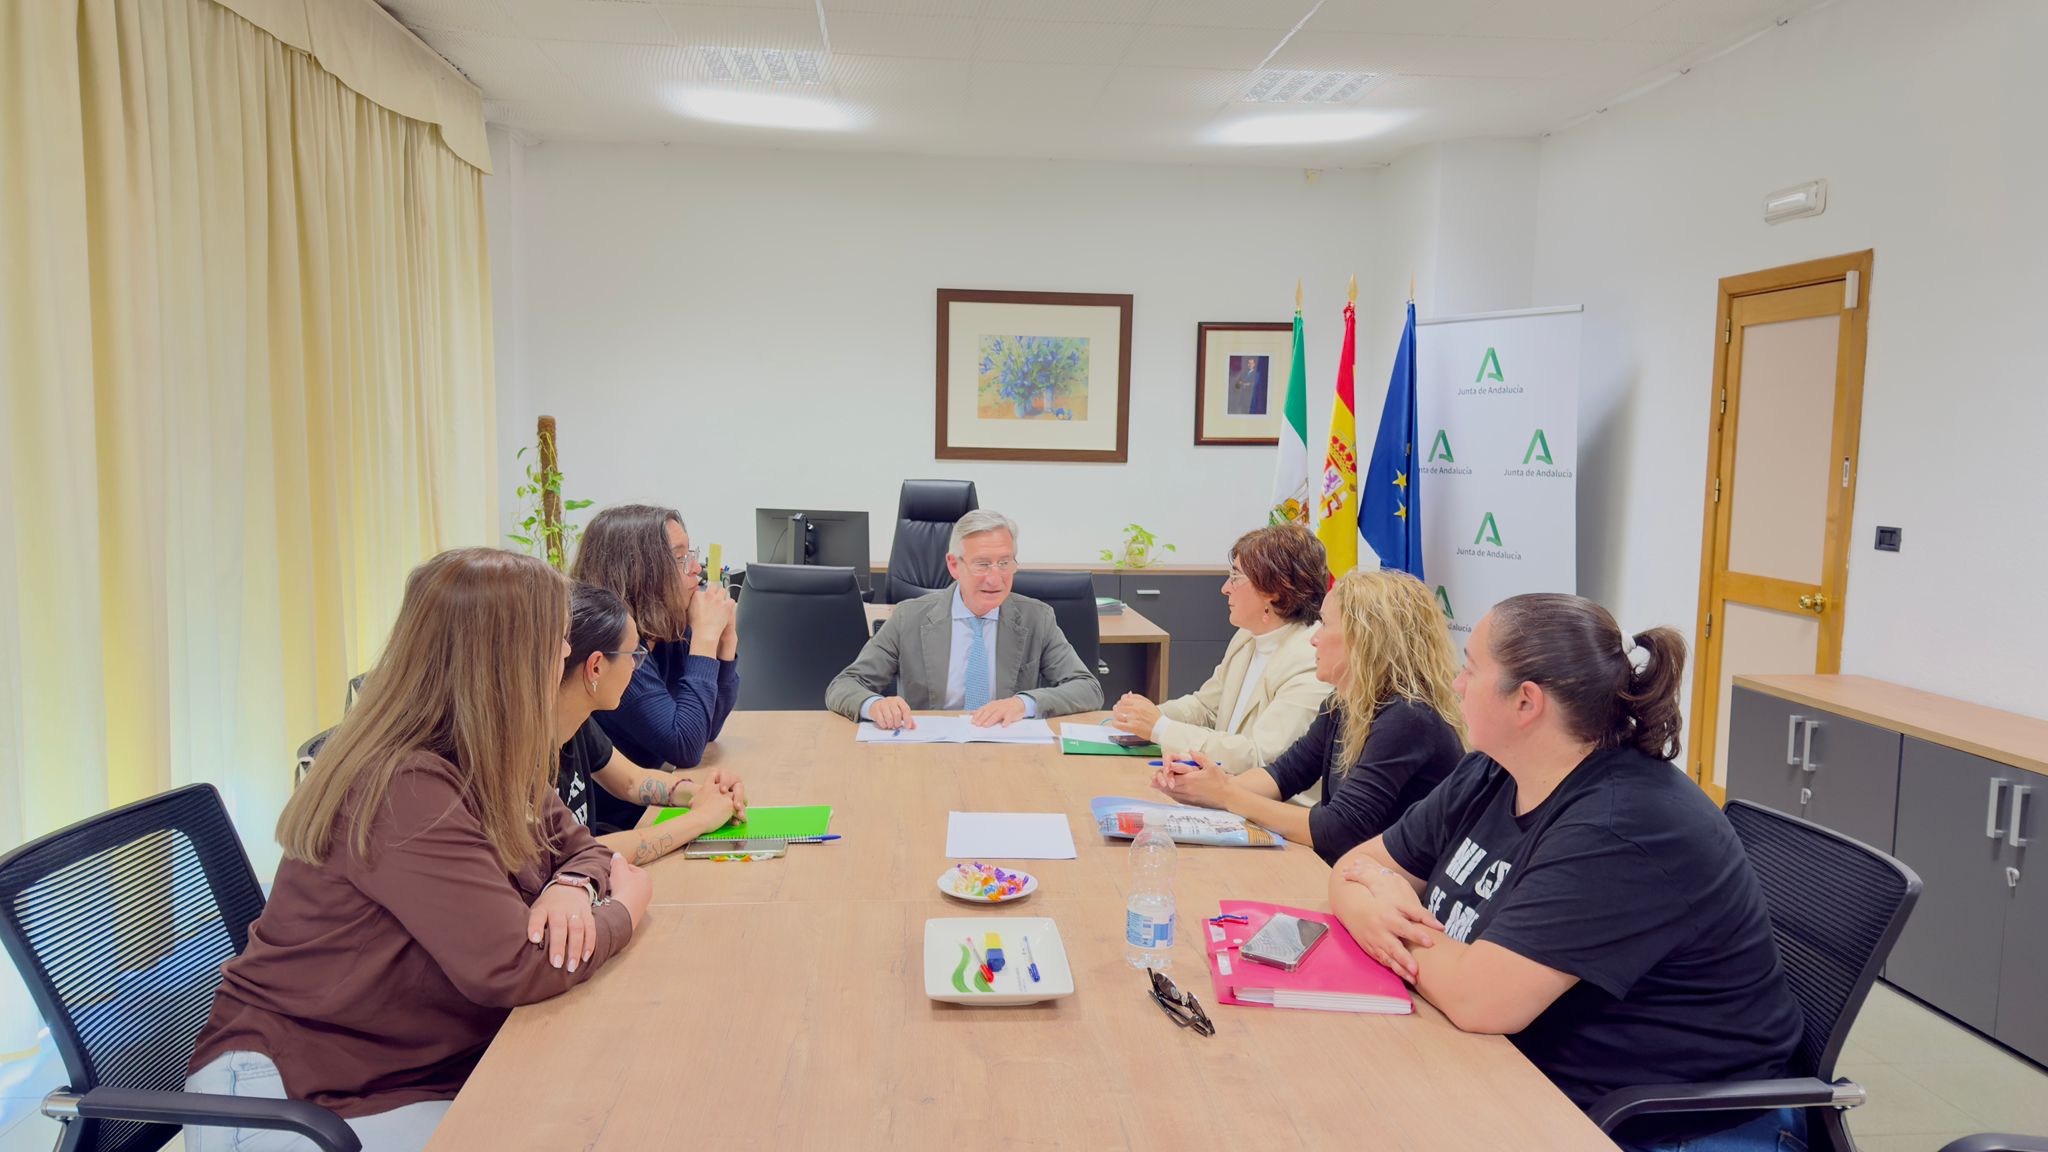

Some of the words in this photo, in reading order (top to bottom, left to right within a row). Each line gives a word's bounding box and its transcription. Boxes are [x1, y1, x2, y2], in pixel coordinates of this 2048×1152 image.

[1458, 387, 1477, 395] Junta
[1478, 386, 1487, 395] de
[1487, 384, 1524, 394] Andalucía
[1430, 466, 1438, 474] de
[1439, 465, 1472, 475] Andalucía
[1504, 468, 1524, 477] Junta
[1525, 469, 1535, 477] de
[1536, 469, 1573, 478] Andalucía
[1456, 547, 1475, 556] Junta
[1476, 549, 1485, 557] de
[1486, 550, 1522, 560] Andalucía
[1447, 623, 1472, 633] dalucía
